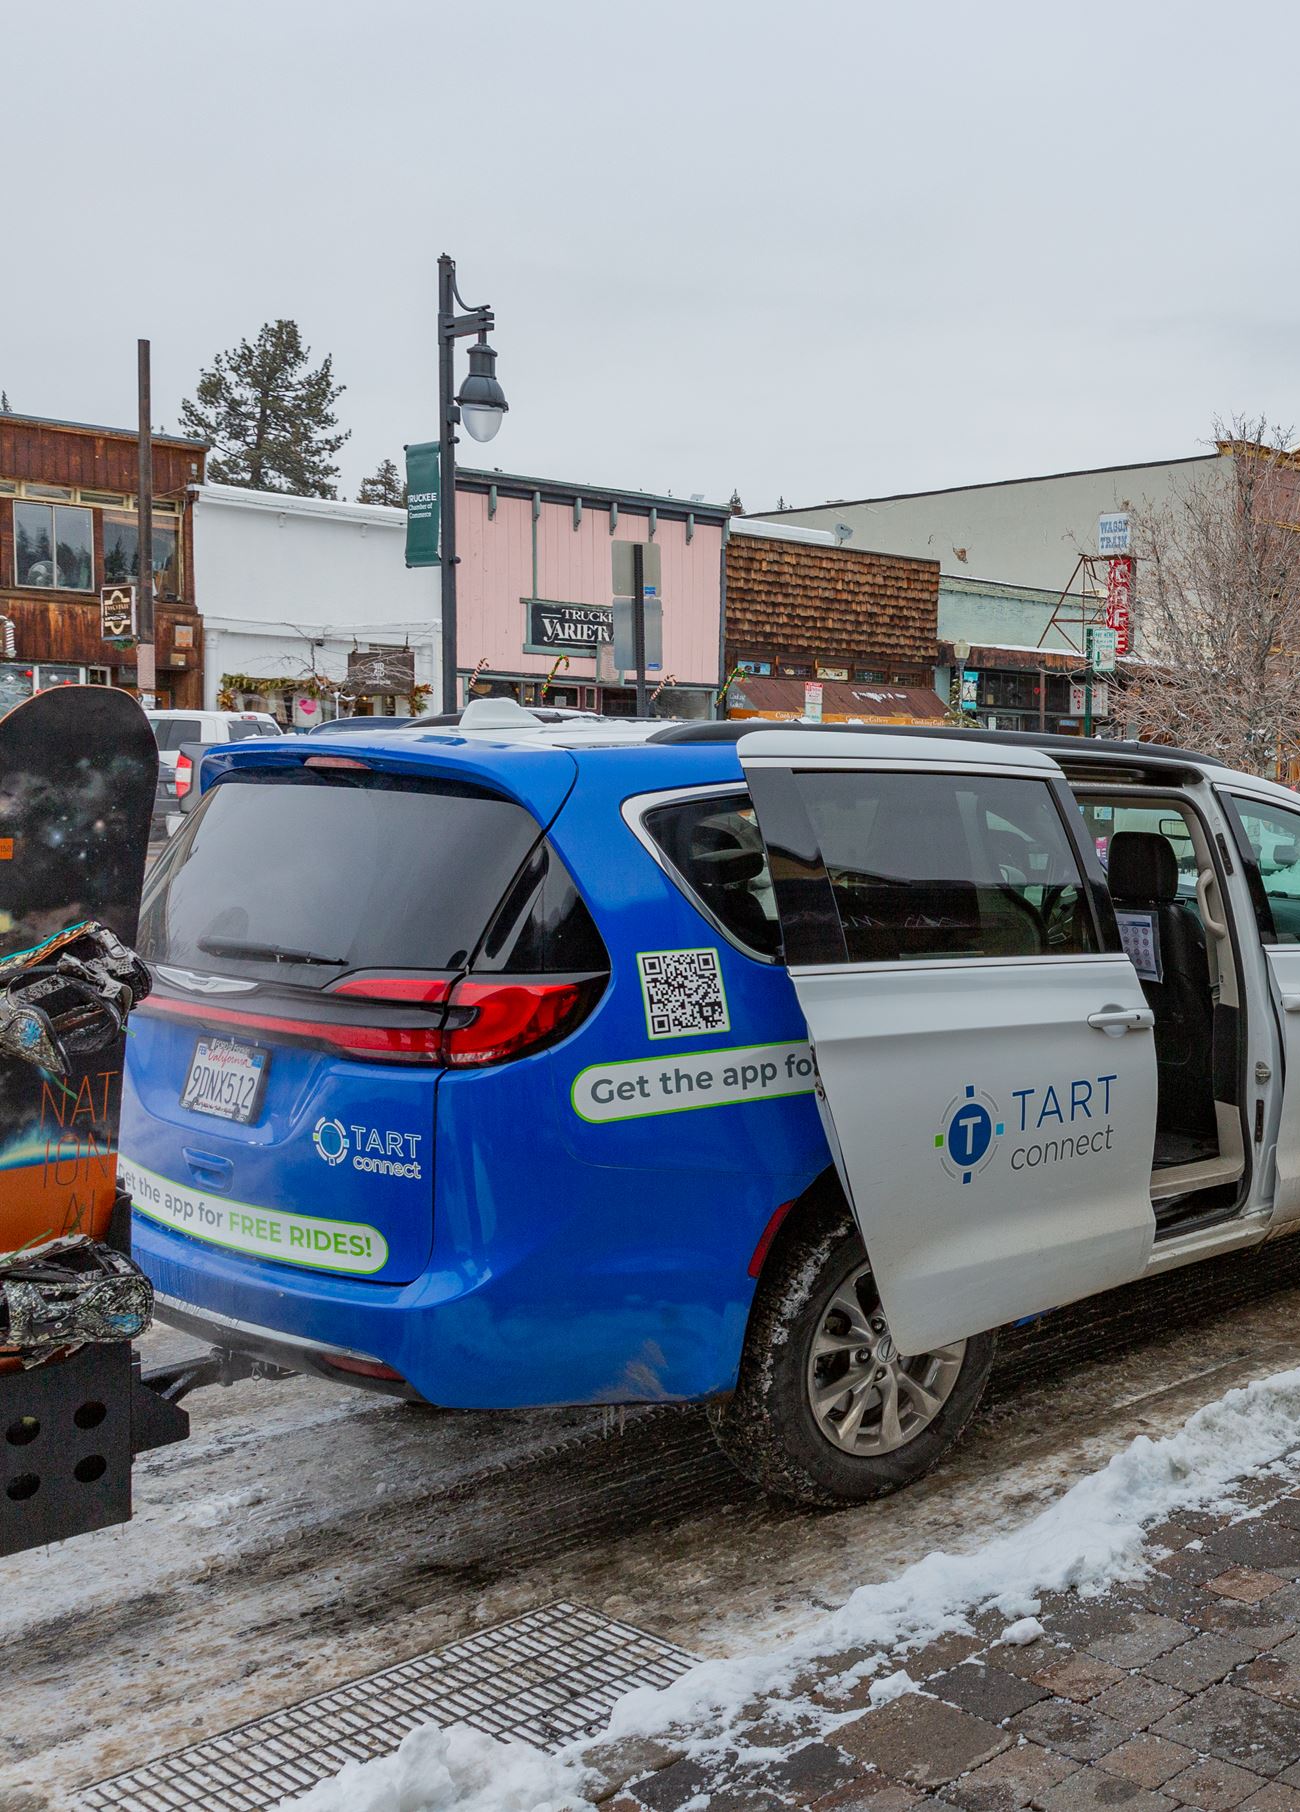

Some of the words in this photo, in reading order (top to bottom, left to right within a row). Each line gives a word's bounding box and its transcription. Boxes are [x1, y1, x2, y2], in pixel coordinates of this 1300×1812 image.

[408, 492, 437, 503] TRUCKEE
[1100, 520, 1129, 534] WAGON
[1100, 536, 1128, 549] TRAIN
[207, 1048, 252, 1069] California
[188, 1065, 255, 1110] 9DNX512
[590, 1075, 651, 1104] Get
[659, 1068, 713, 1095] the
[723, 1061, 777, 1090] app
[784, 1053, 815, 1078] fo
[1012, 1074, 1118, 1131] TART
[350, 1125, 422, 1158] TART
[958, 1115, 982, 1156] T
[1010, 1124, 1114, 1171] connect
[352, 1155, 422, 1180] connect
[139, 1176, 161, 1204] the
[165, 1191, 194, 1221] app
[198, 1202, 223, 1228] for
[228, 1211, 283, 1243] FREE
[289, 1225, 373, 1258] RIDES!
